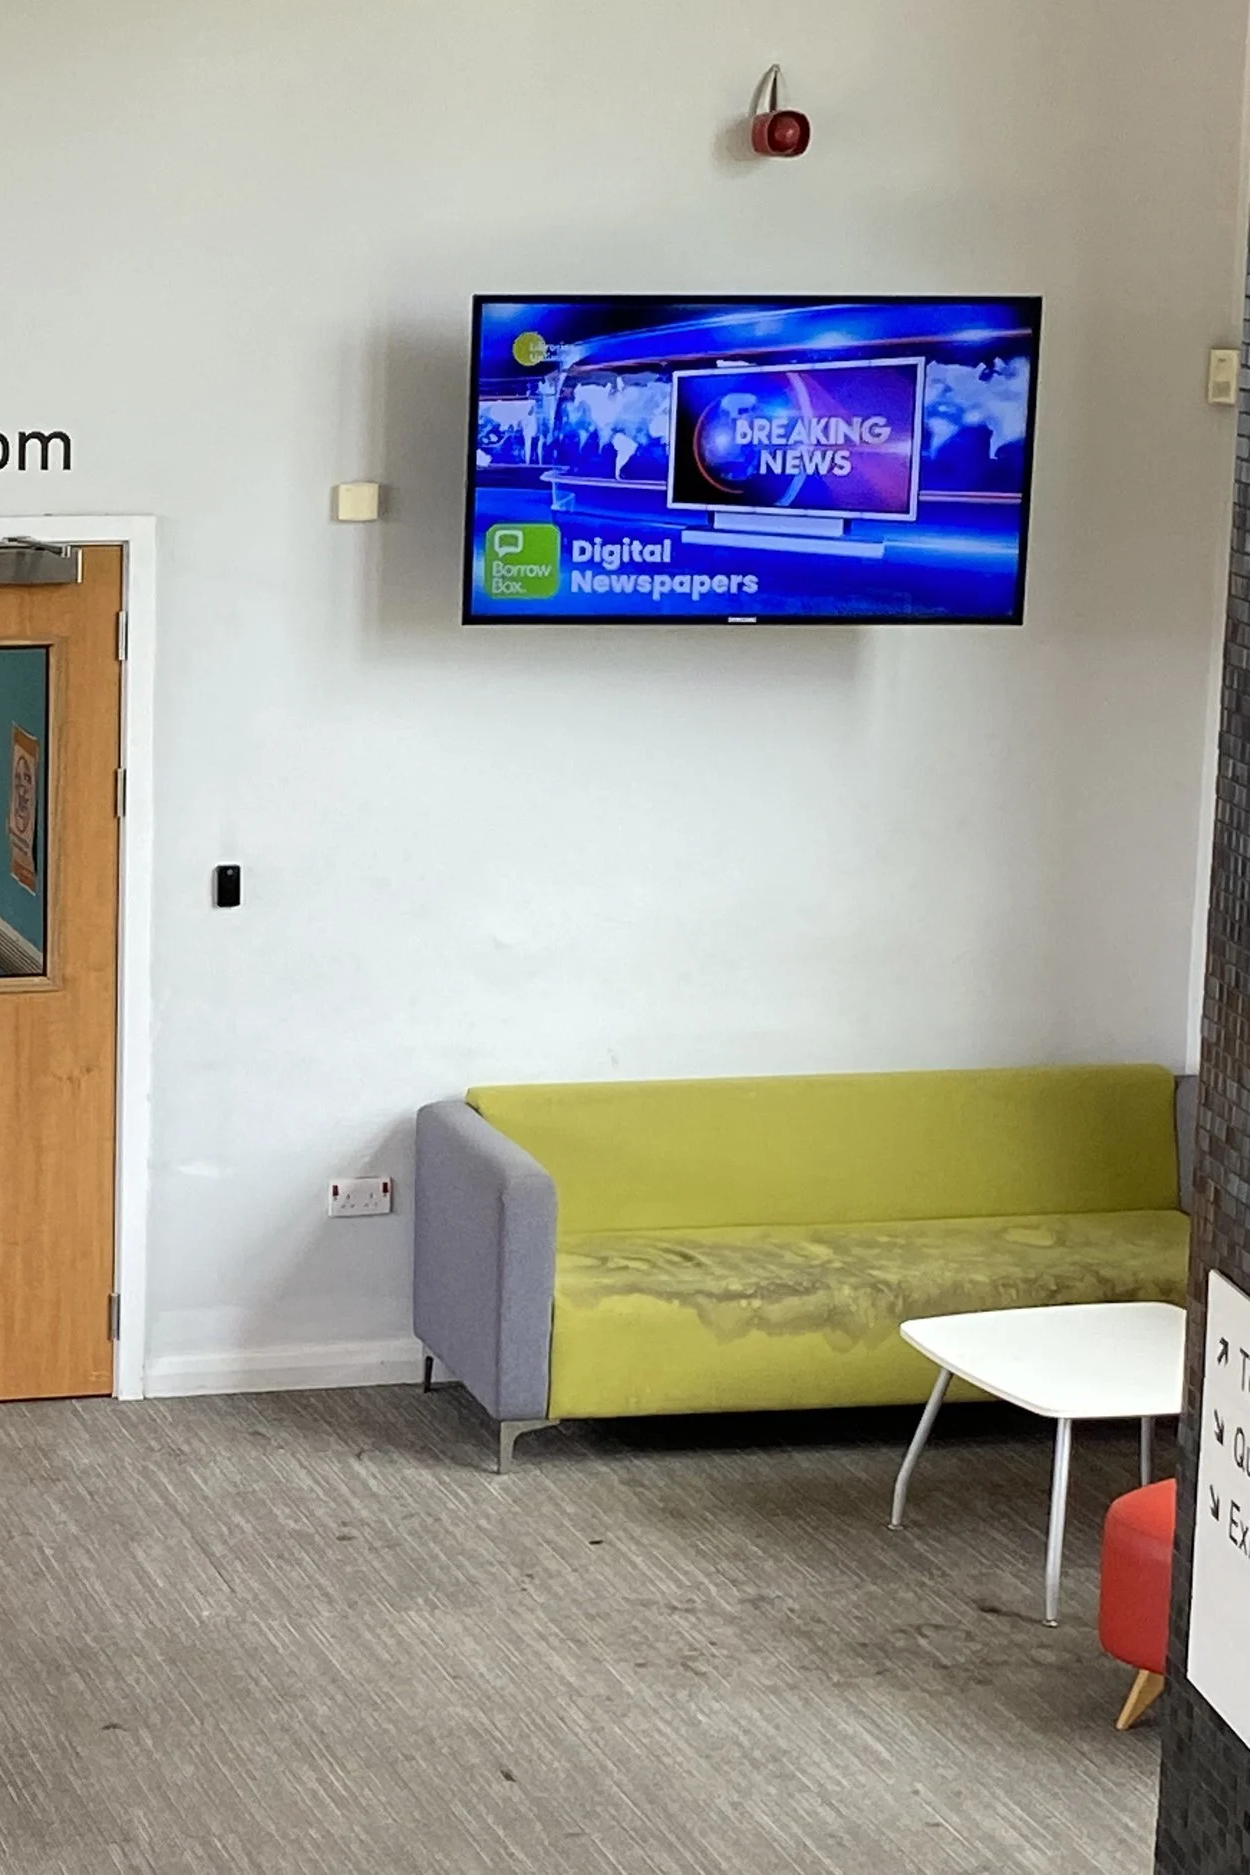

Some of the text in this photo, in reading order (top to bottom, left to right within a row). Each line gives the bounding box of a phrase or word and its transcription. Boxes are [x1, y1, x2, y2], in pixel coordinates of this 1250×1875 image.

[735, 416, 892, 445] BREAKING
[759, 449, 852, 477] NEWS
[571, 537, 672, 571] Digital
[491, 560, 551, 578] Borrow
[570, 569, 759, 601] Newspapers
